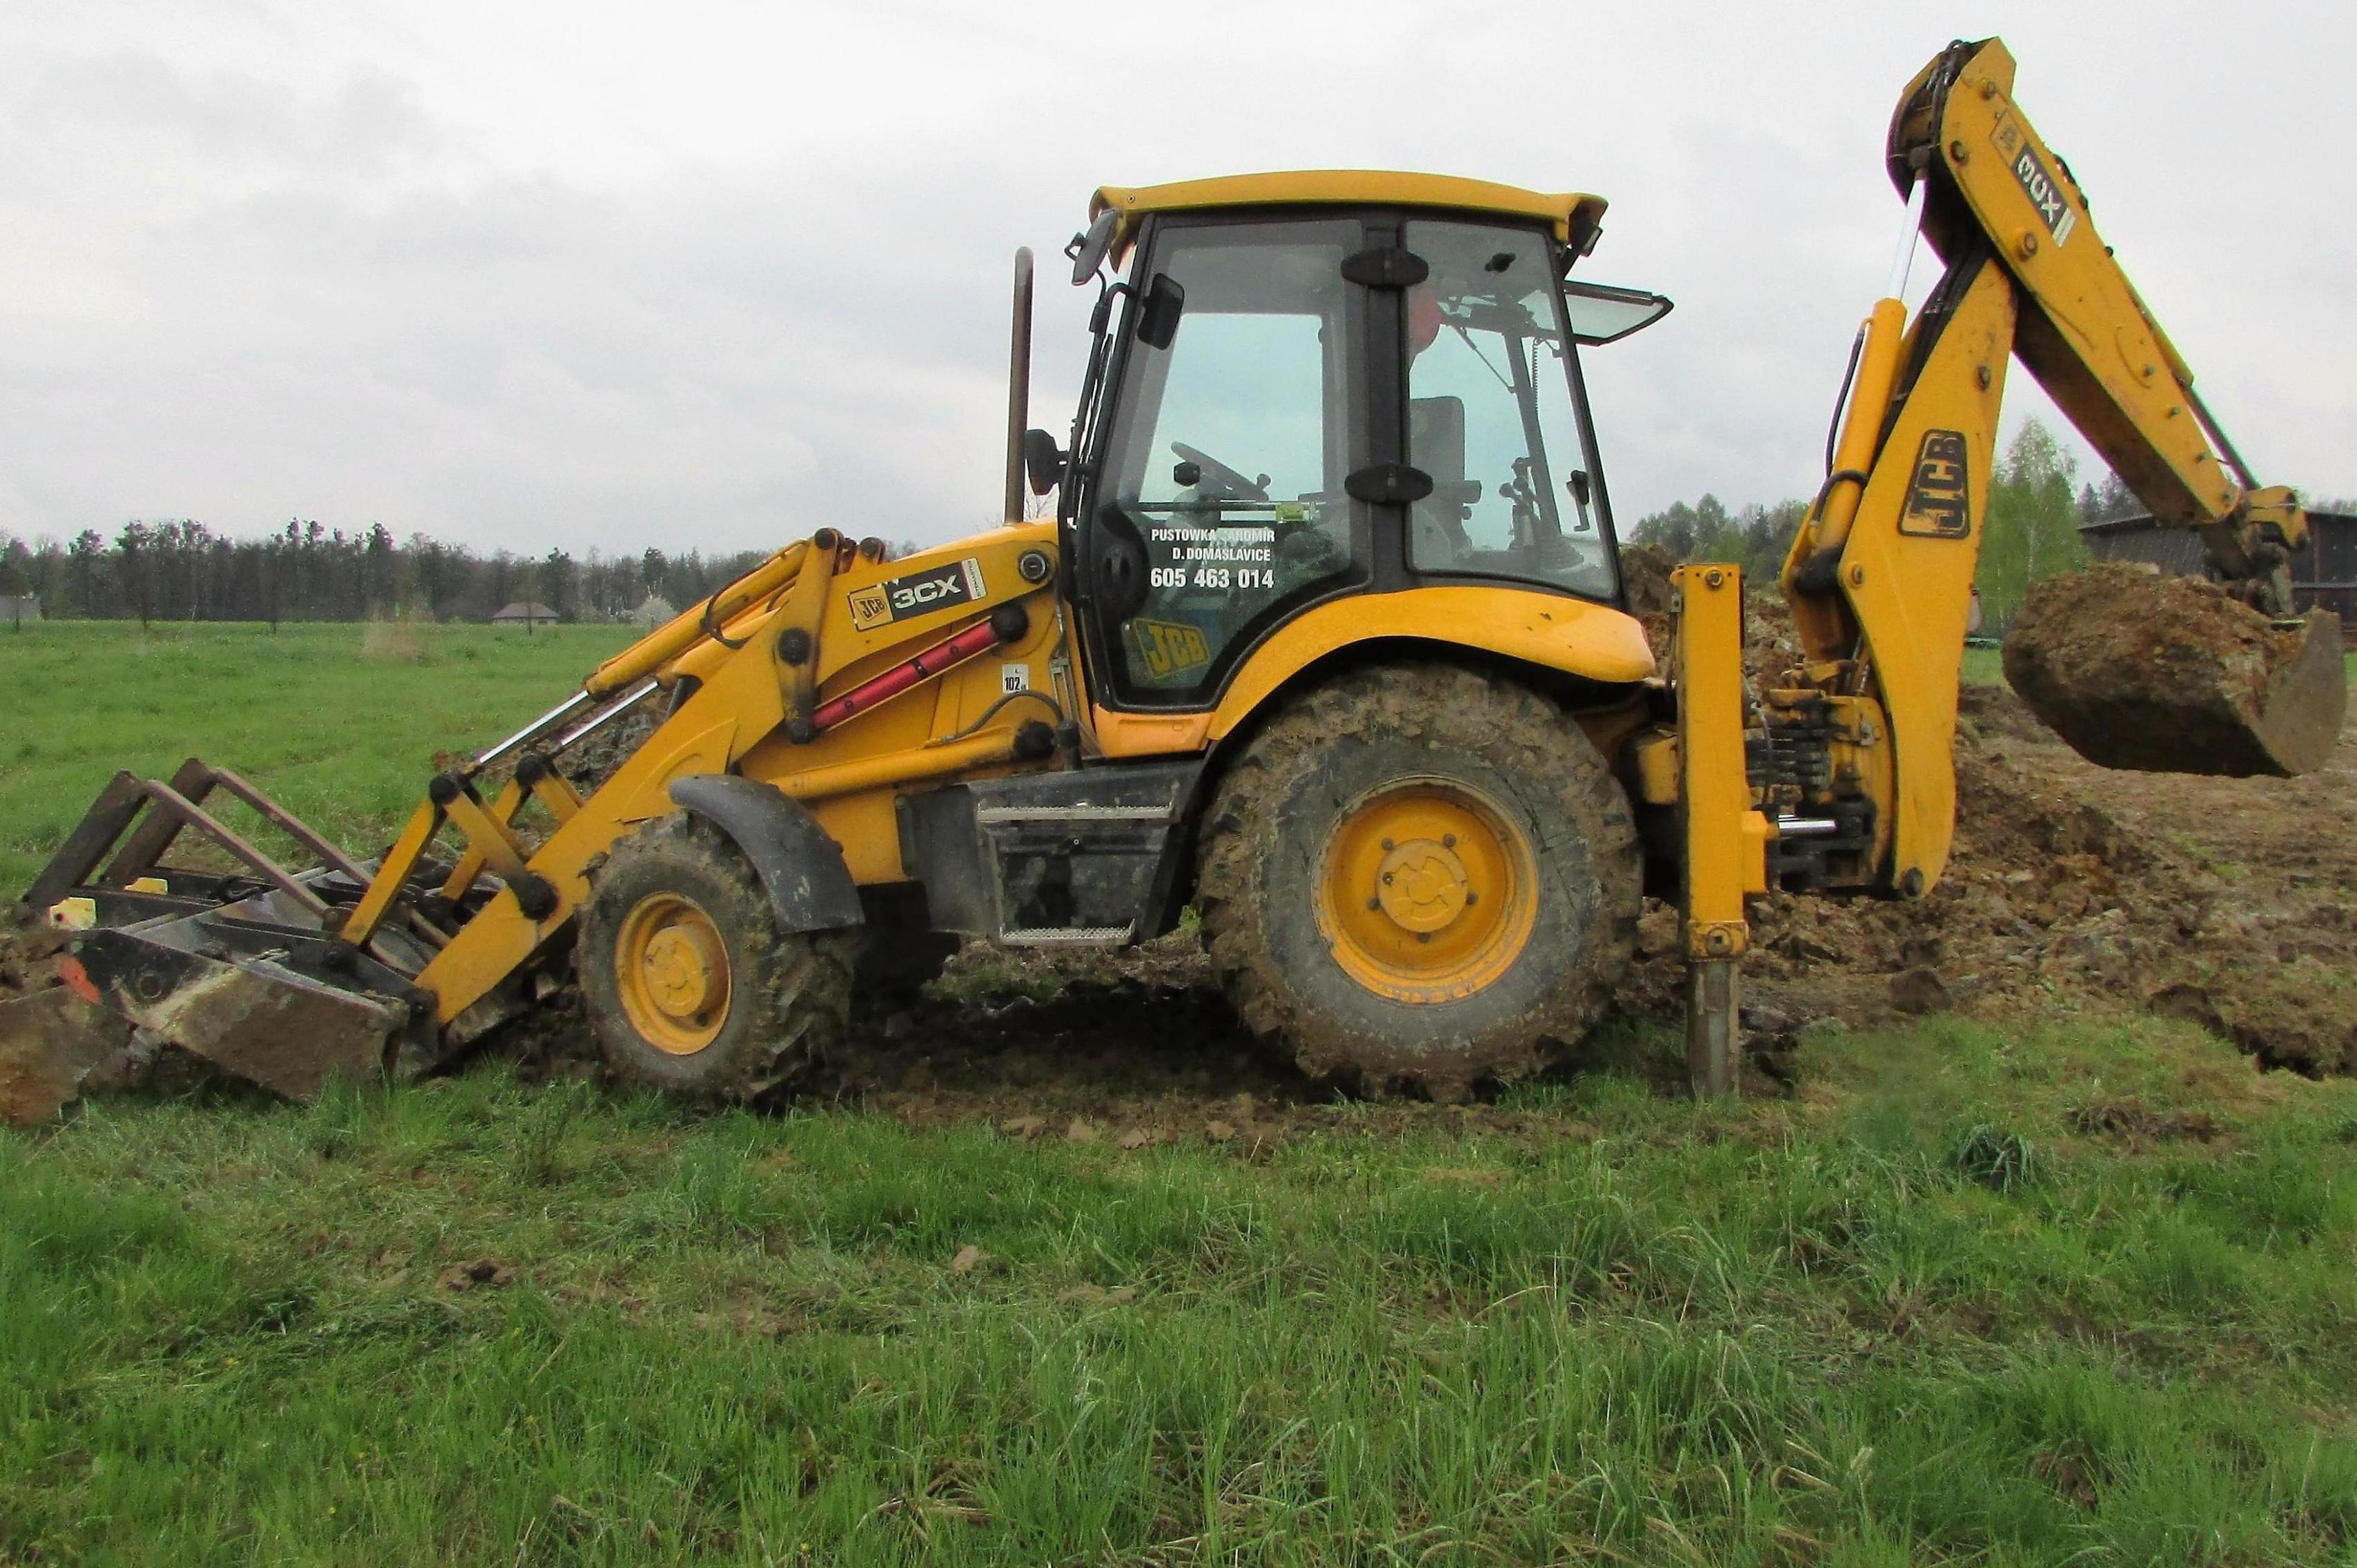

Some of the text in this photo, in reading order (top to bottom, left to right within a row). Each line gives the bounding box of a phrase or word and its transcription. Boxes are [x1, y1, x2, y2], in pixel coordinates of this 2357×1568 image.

[1910, 436, 1965, 530] JCB
[1151, 528, 1216, 542] PUSTOWKA
[1150, 568, 1274, 588] 605 463 014
[859, 575, 962, 619] JCB 3CX
[1147, 622, 1205, 674] JCB
[1004, 677, 1020, 691] 102
